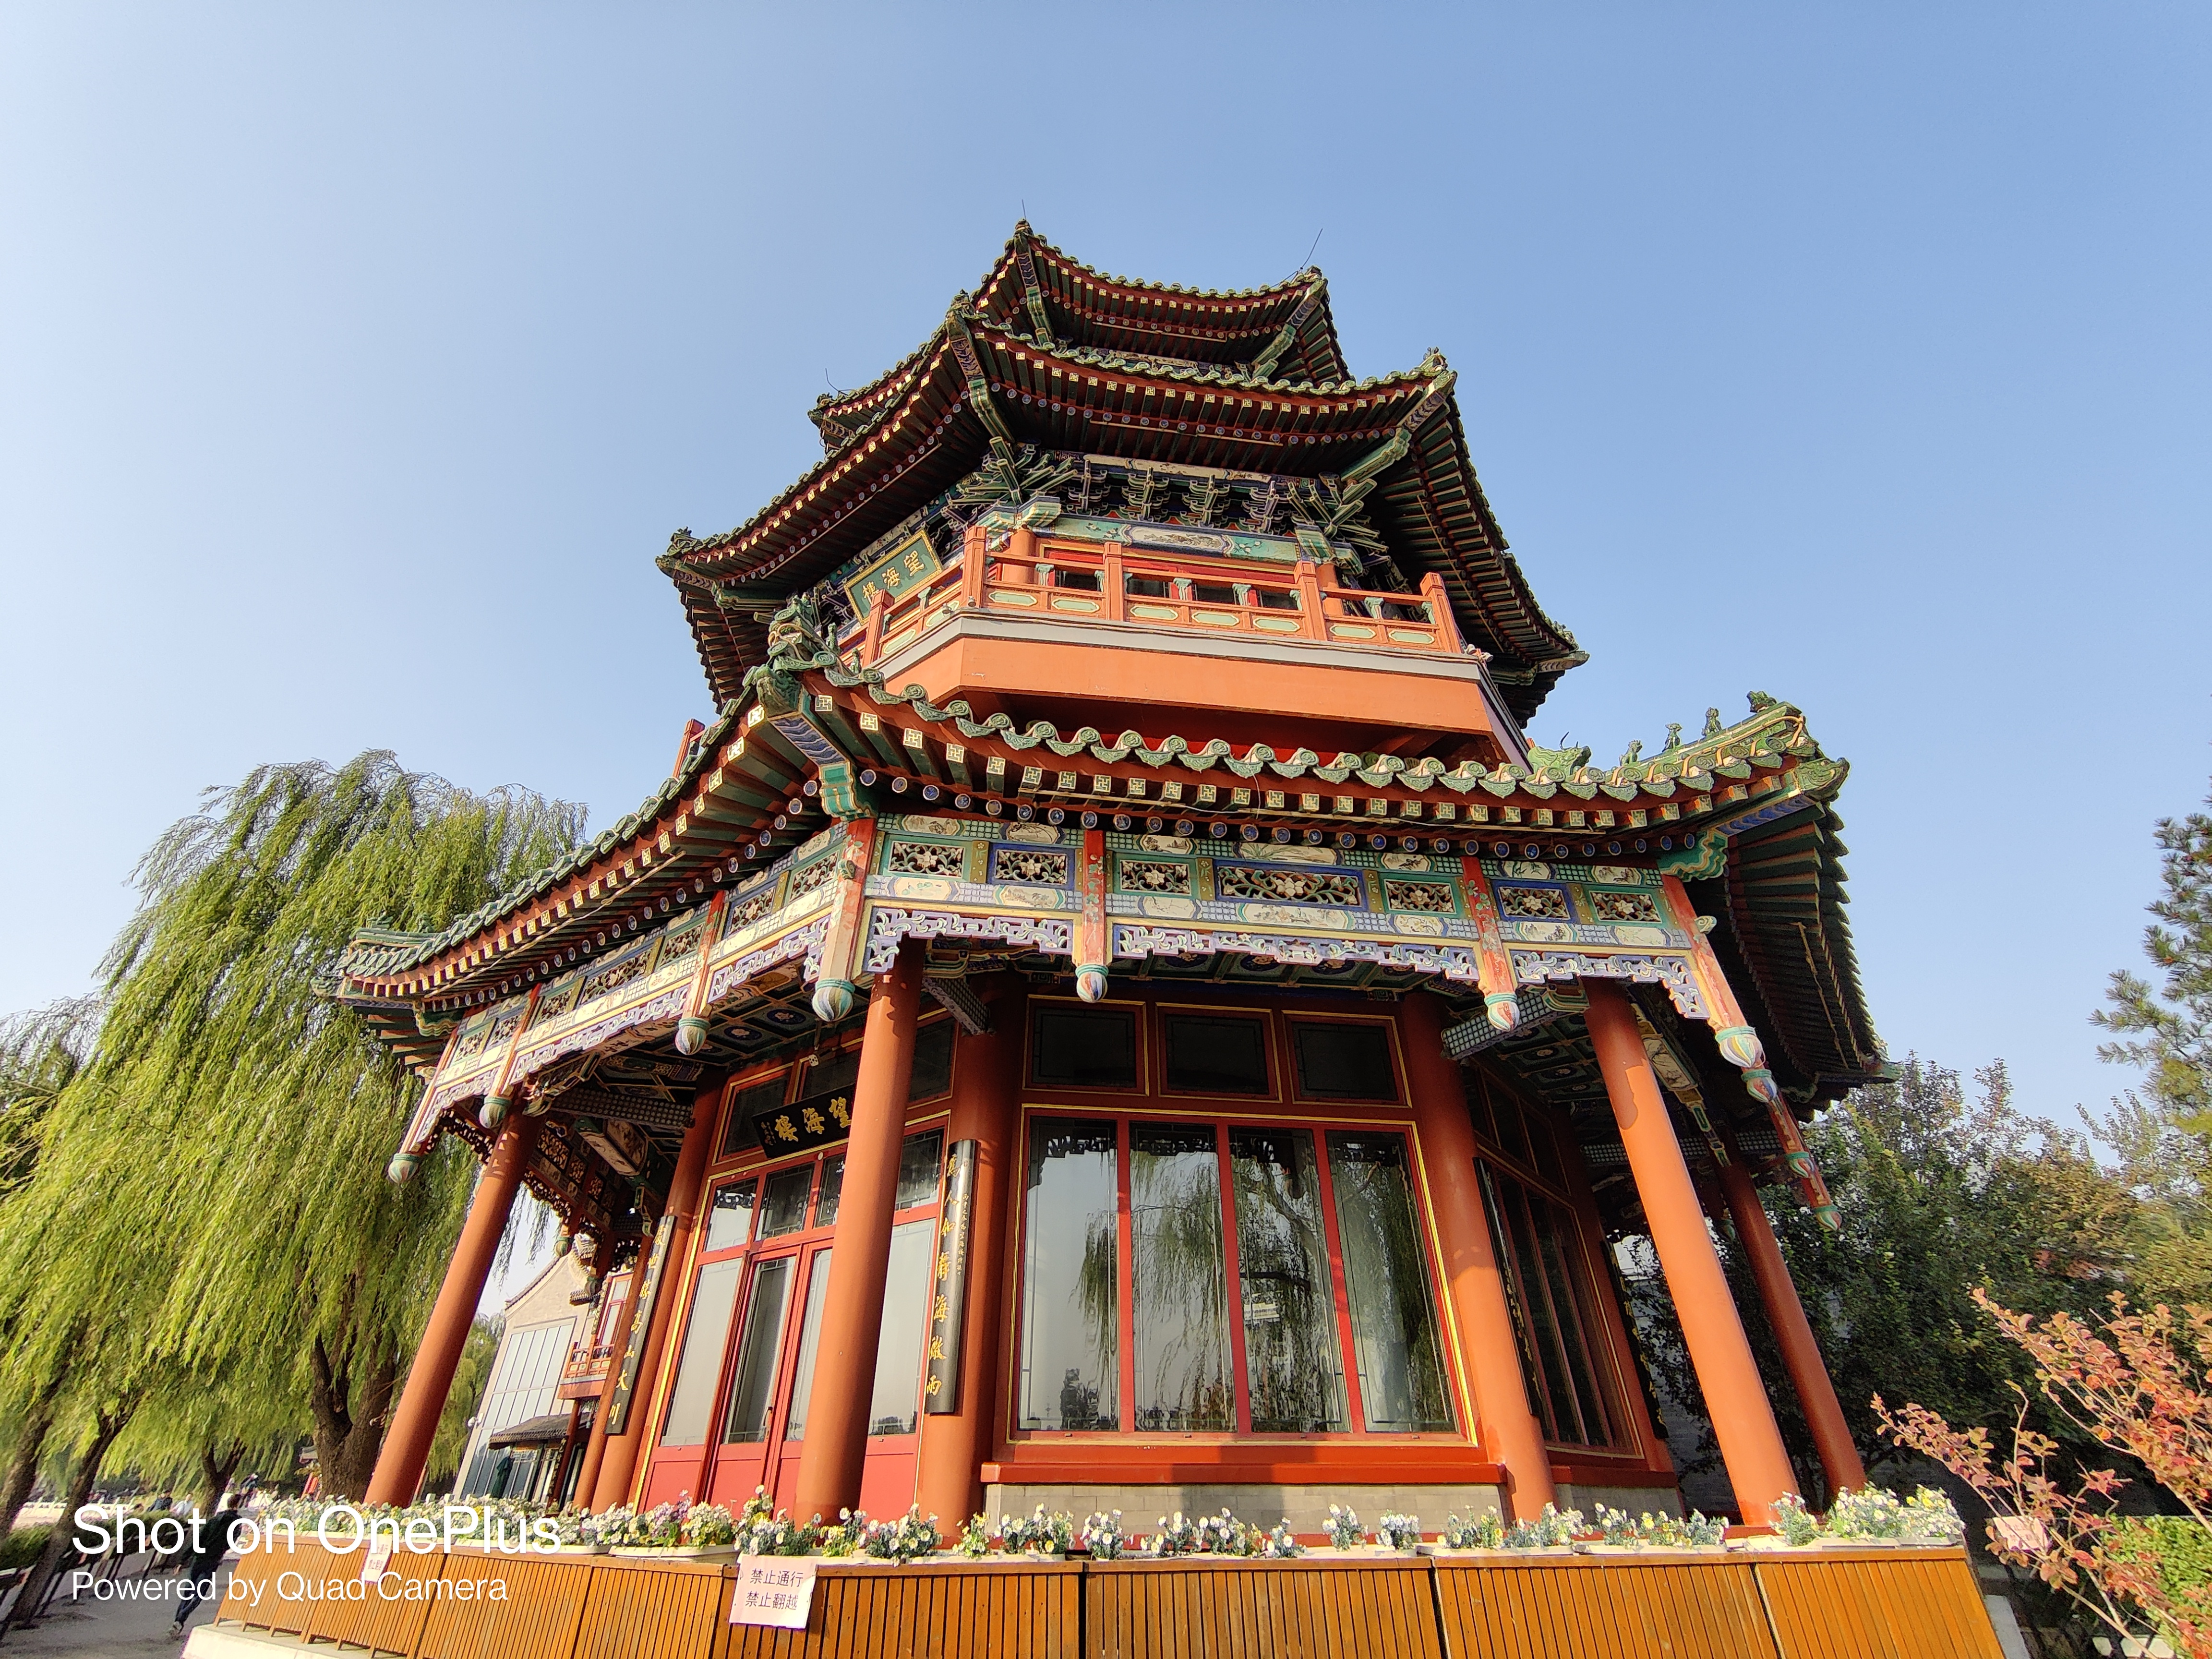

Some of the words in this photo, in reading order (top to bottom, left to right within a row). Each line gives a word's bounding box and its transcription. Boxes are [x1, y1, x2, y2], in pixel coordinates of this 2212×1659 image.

[750, 1568, 804, 1587] 禁止通行
[745, 1591, 799, 1610] 禁止翻越
